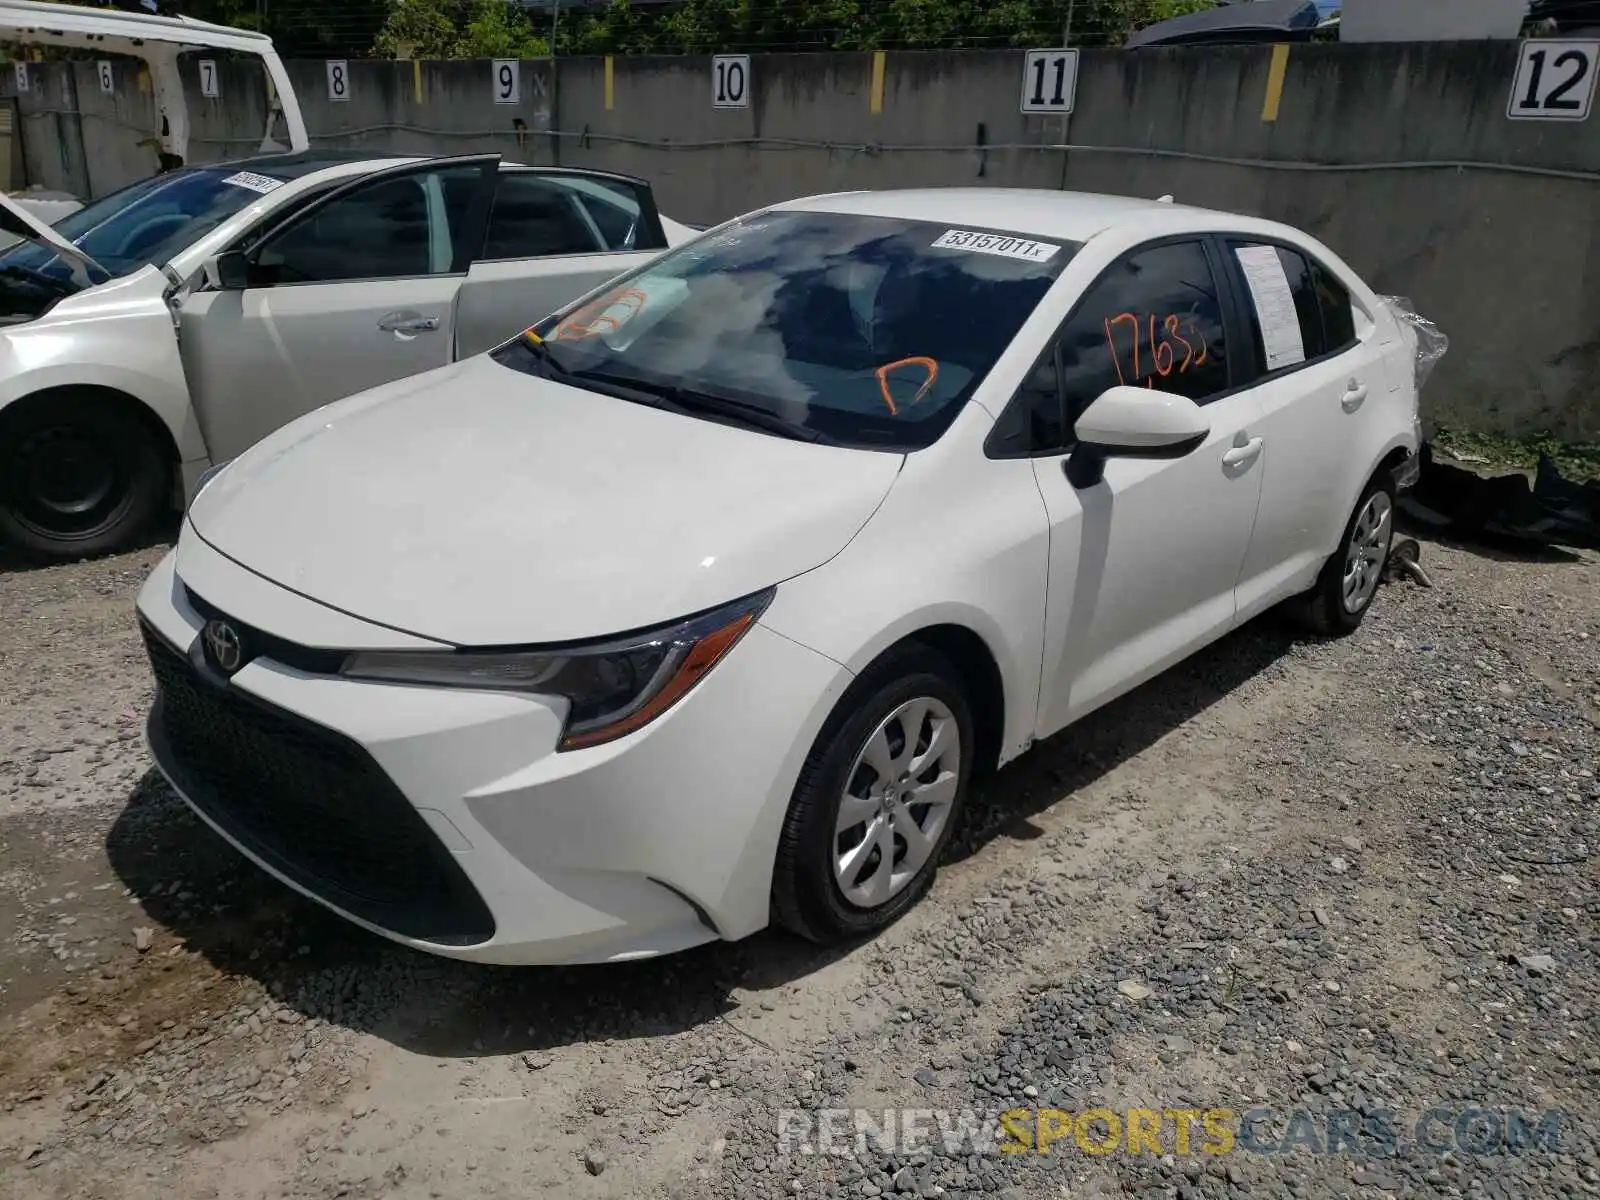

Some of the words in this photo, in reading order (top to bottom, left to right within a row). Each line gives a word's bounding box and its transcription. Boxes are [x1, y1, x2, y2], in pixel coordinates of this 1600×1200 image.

[102, 65, 110, 89] 6
[203, 65, 212, 92] 7
[332, 65, 345, 96] 8
[499, 64, 513, 99] 9
[716, 61, 744, 101] 10
[1030, 57, 1066, 105] 11
[1519, 49, 1589, 110] 12
